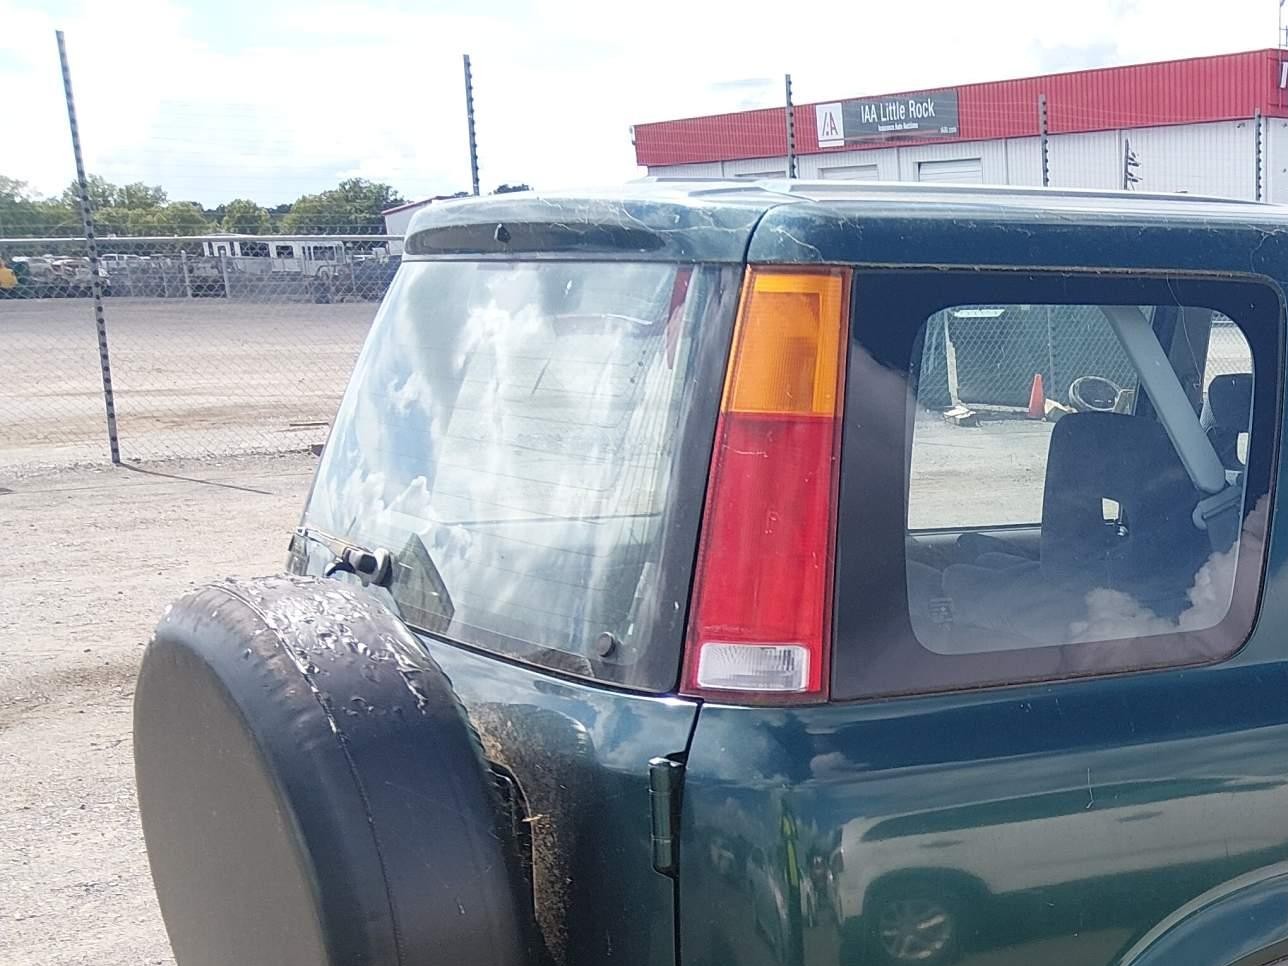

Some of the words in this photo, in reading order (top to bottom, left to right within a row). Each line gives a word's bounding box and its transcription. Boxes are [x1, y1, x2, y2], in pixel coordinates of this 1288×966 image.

[861, 104, 878, 123] IAA
[880, 102, 906, 122] Little
[909, 98, 936, 119] Rock
